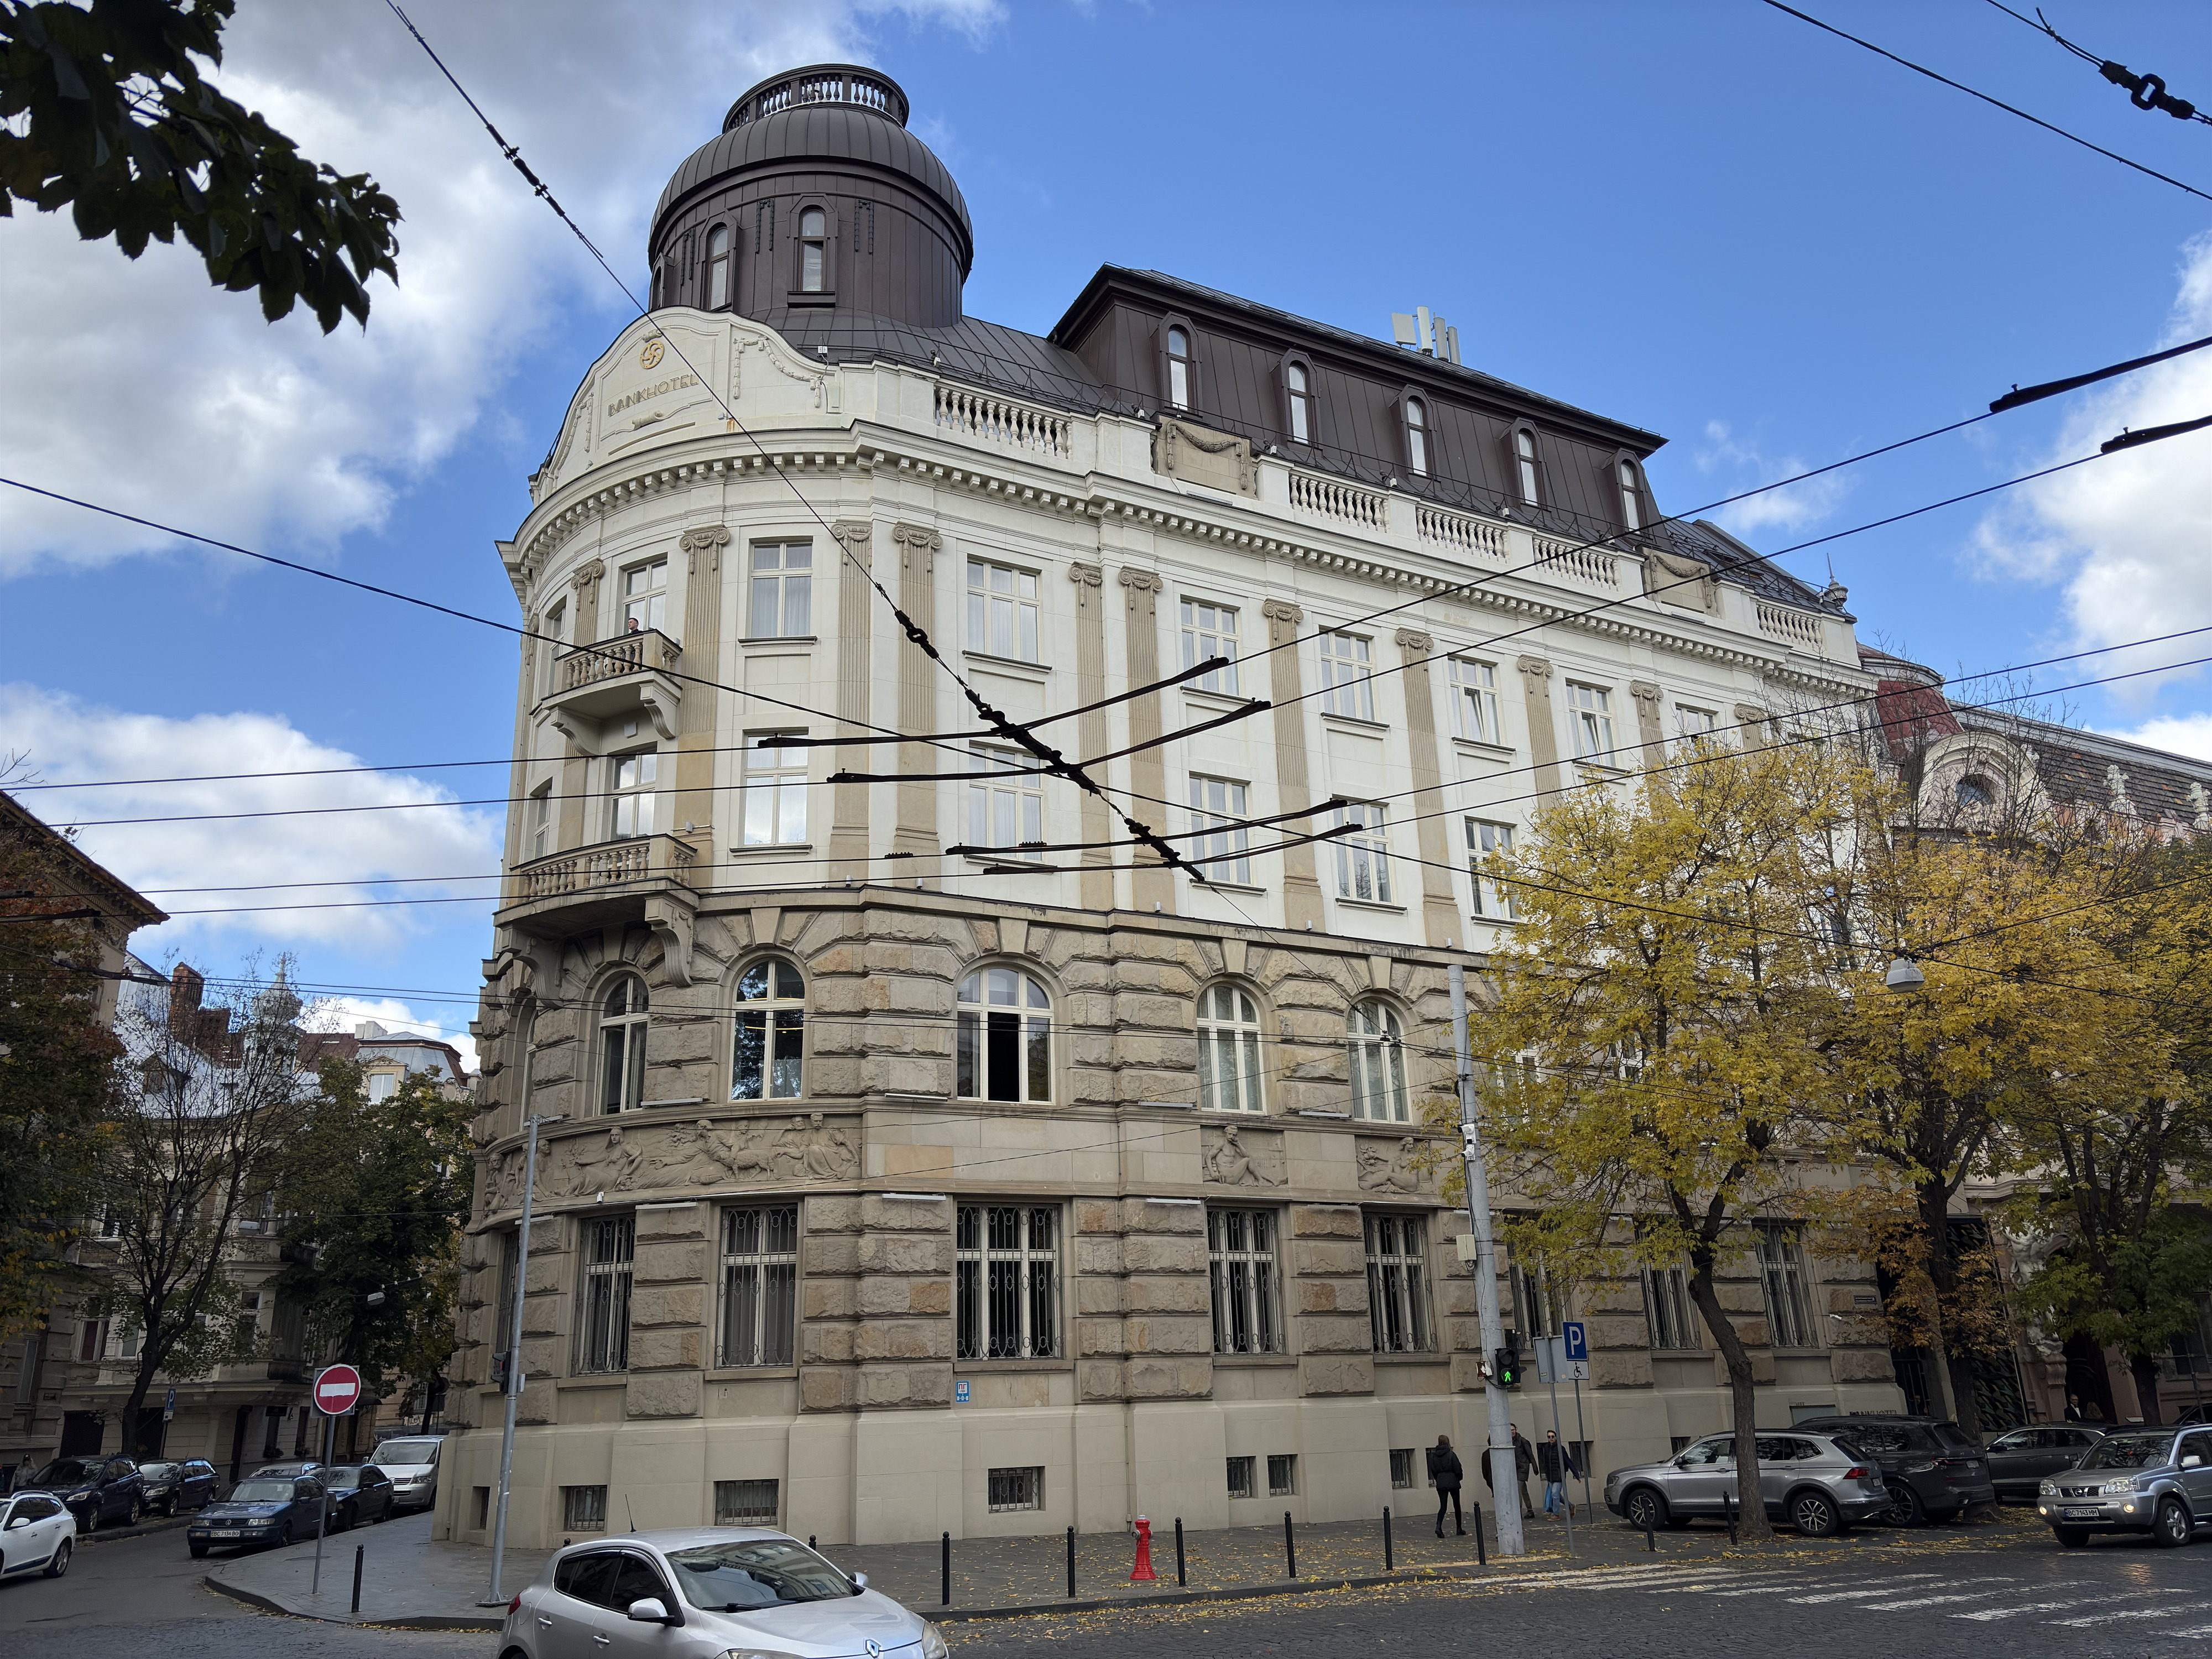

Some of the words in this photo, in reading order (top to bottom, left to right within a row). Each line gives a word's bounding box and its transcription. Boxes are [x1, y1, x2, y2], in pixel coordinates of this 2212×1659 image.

[608, 373, 699, 417] BANKHOTEL
[1569, 1326, 1582, 1355] P
[168, 1390, 174, 1408] P
